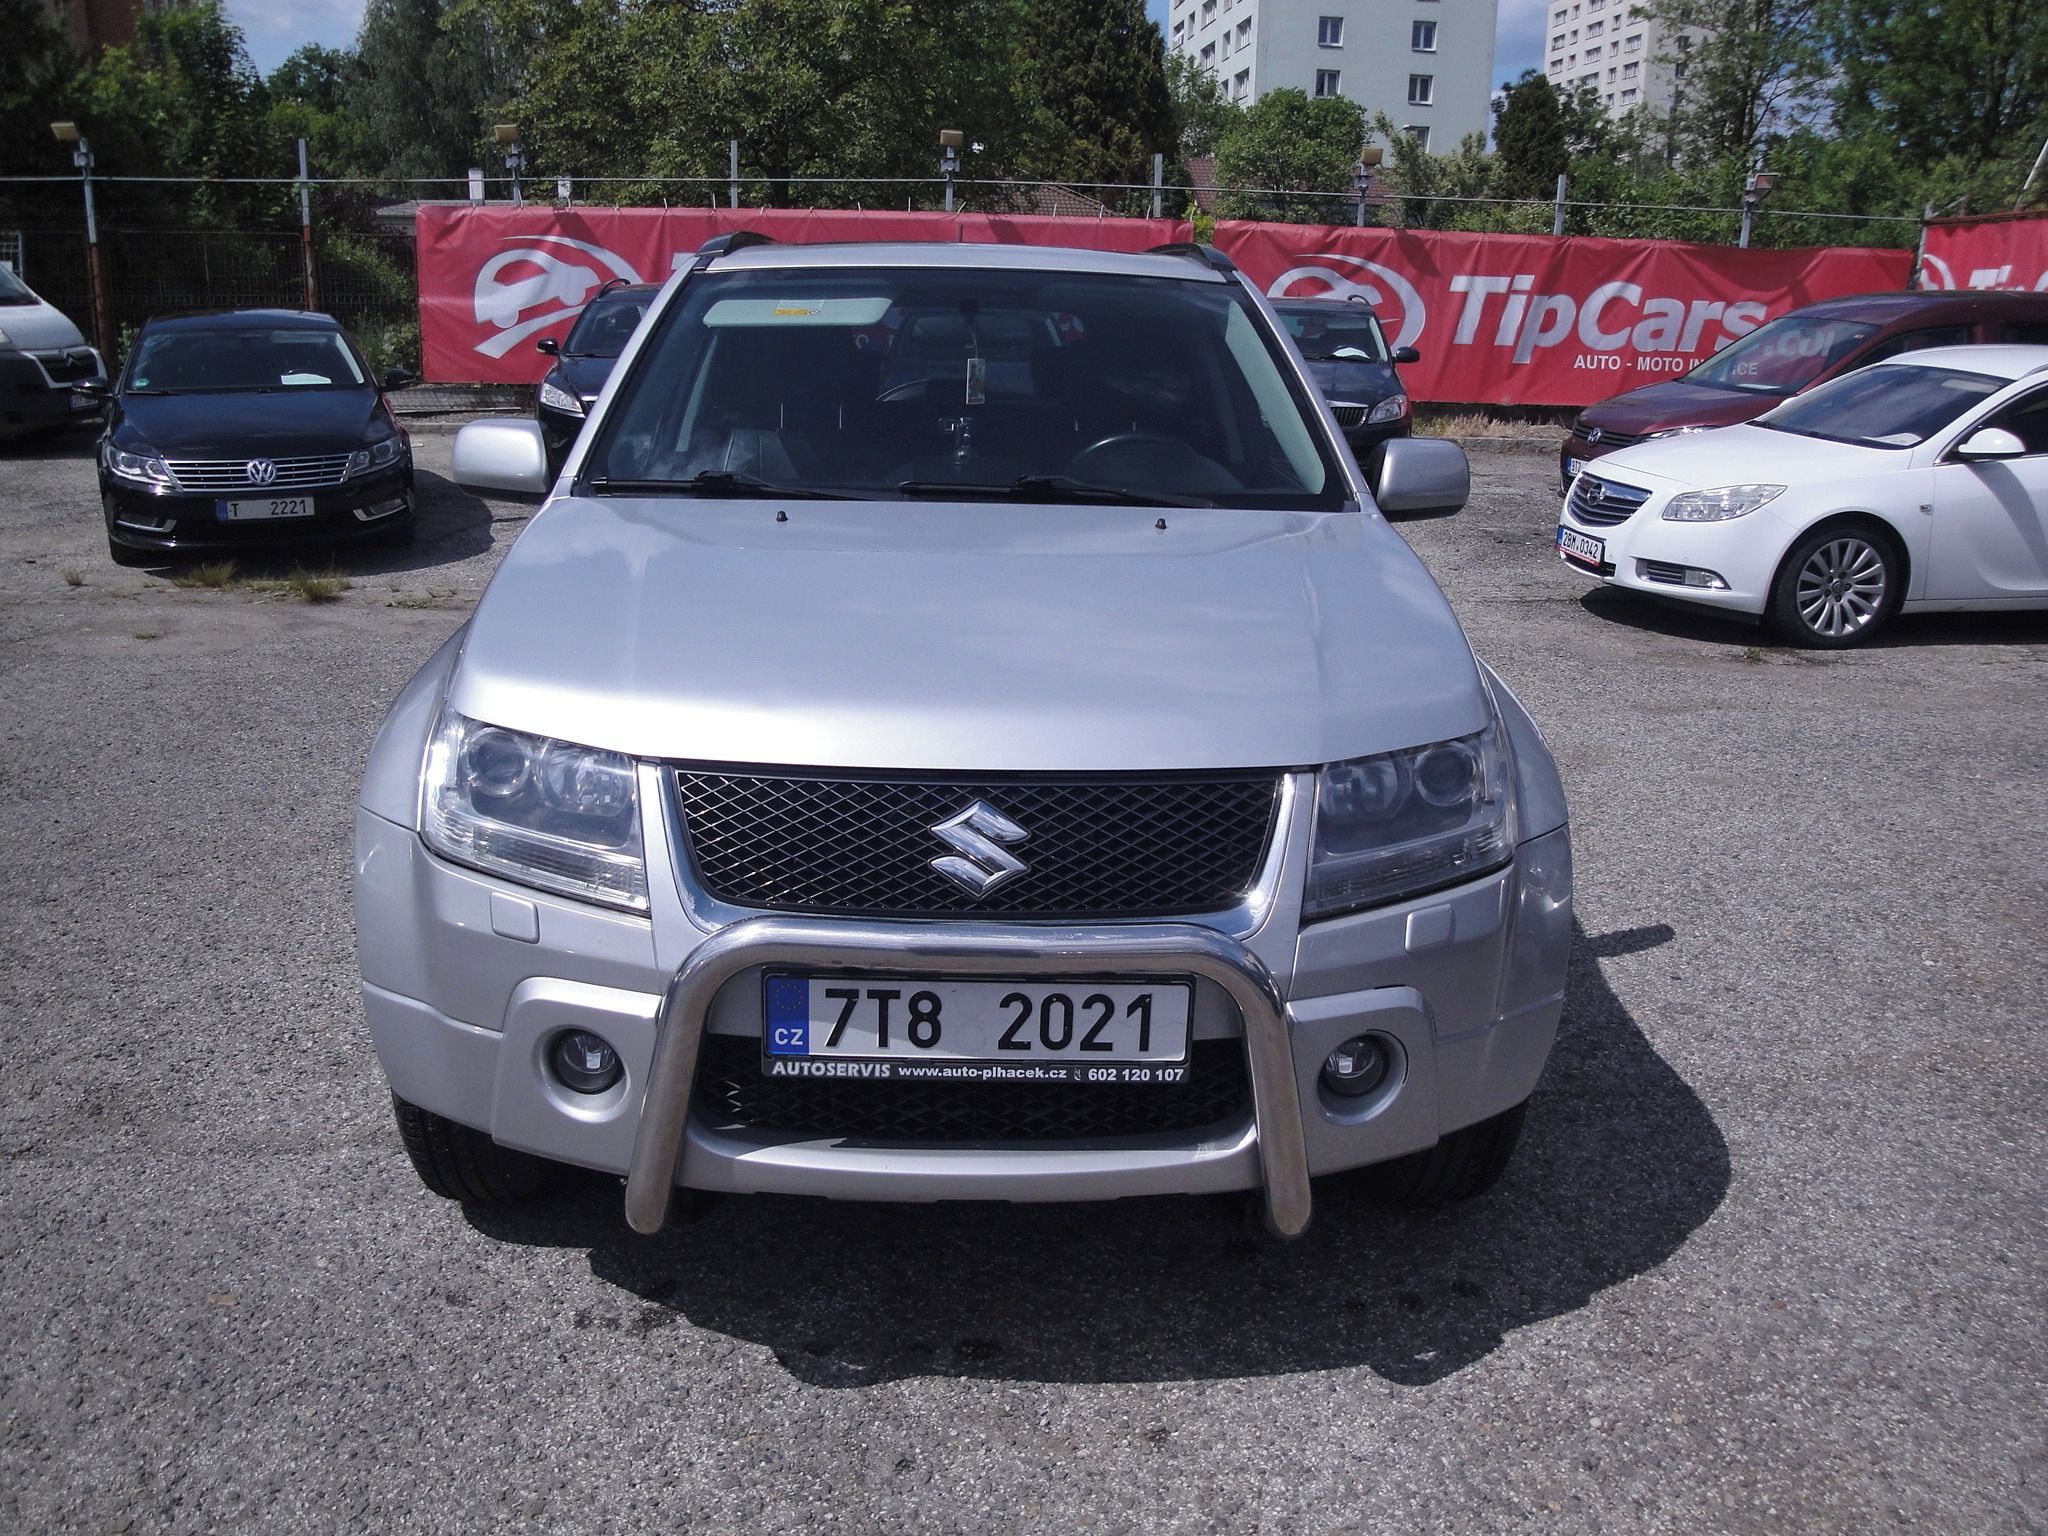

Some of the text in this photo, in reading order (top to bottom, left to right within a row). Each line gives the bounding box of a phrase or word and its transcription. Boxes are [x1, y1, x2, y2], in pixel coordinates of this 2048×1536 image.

[1574, 354, 1620, 370] AUTO
[1637, 356, 1684, 372] MOTO
[270, 499, 306, 516] 2221
[1579, 538, 1599, 559] 0342
[774, 987, 1153, 1052] CZ 7T8 2021
[772, 1061, 1184, 1082] AUTOSERVIS www.auto-plhacek.cz 602 120 107
